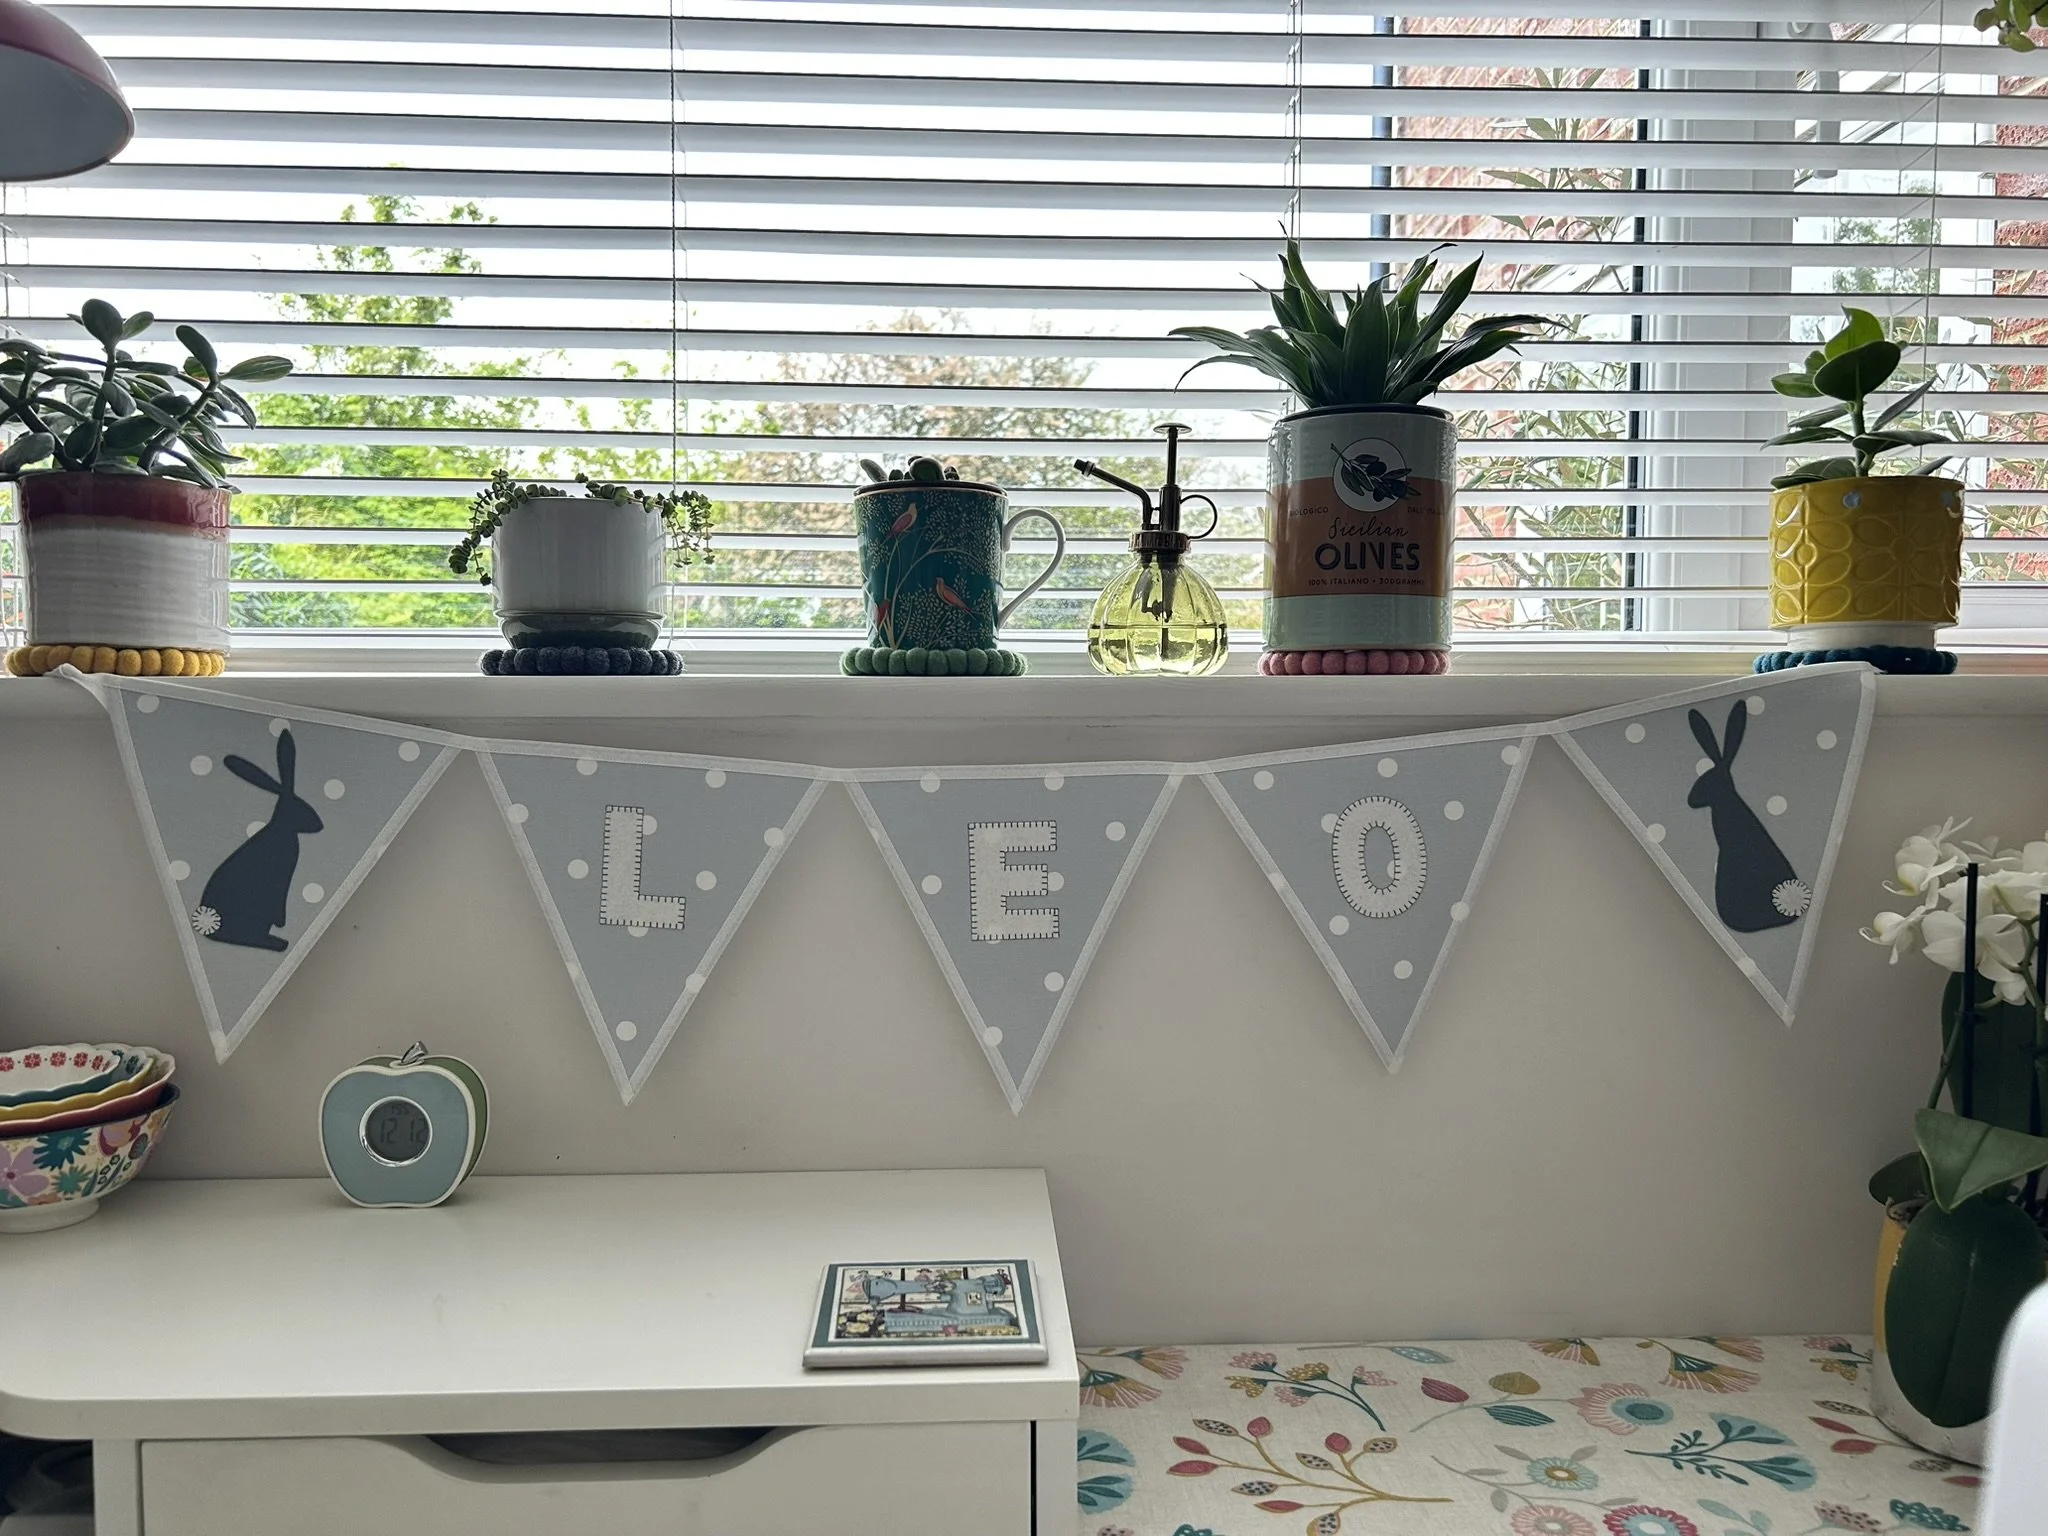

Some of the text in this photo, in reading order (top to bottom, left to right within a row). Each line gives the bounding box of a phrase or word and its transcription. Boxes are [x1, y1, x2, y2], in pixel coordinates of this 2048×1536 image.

[1328, 516, 1409, 539] Sicilian
[1315, 541, 1420, 571] OLIVES
[1308, 579, 1327, 587] 100%
[1330, 577, 1369, 586] ITALIANO
[599, 795, 1429, 942] L E O
